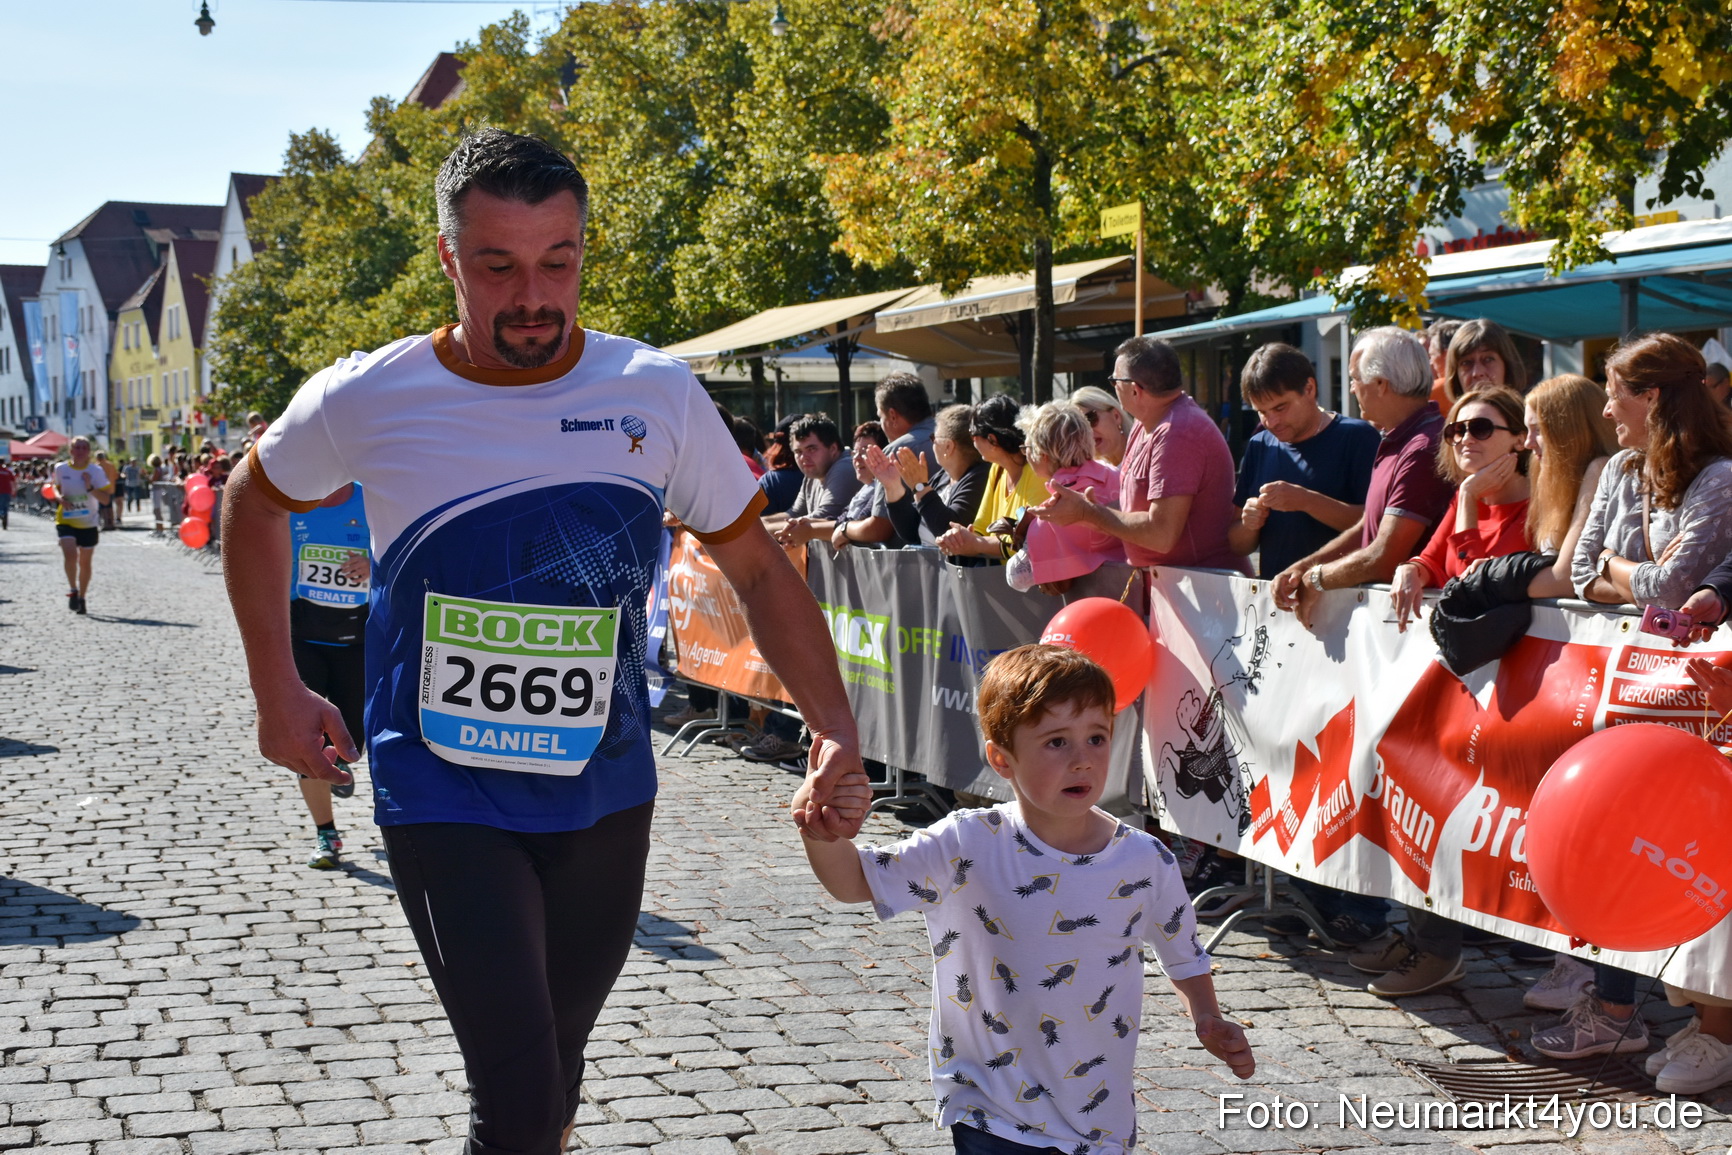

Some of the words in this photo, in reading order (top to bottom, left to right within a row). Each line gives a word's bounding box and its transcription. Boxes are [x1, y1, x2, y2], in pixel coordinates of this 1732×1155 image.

[1109, 213, 1138, 229] Toiletten
[560, 418, 614, 432] Schmer.IT
[306, 548, 363, 563] BOC
[308, 589, 356, 603] RENATE
[441, 606, 601, 650] BOCK
[689, 641, 728, 668] Agentur
[441, 656, 594, 717] 2669
[599, 671, 607, 681] D
[1573, 702, 1588, 727] Seit
[1582, 667, 1598, 698] 1929
[1618, 683, 1711, 707] VERZURRSYS
[459, 724, 567, 755] DANIEL
[1469, 724, 1481, 746] 1929
[1467, 748, 1475, 764] Seit
[1281, 788, 1300, 838] Braun
[1312, 778, 1351, 840] Braun
[1364, 752, 1435, 853] Braun
[1463, 784, 1528, 864] Bra
[1390, 822, 1404, 848] Sicher
[1405, 841, 1413, 857] ist
[1413, 852, 1432, 875] sicher
